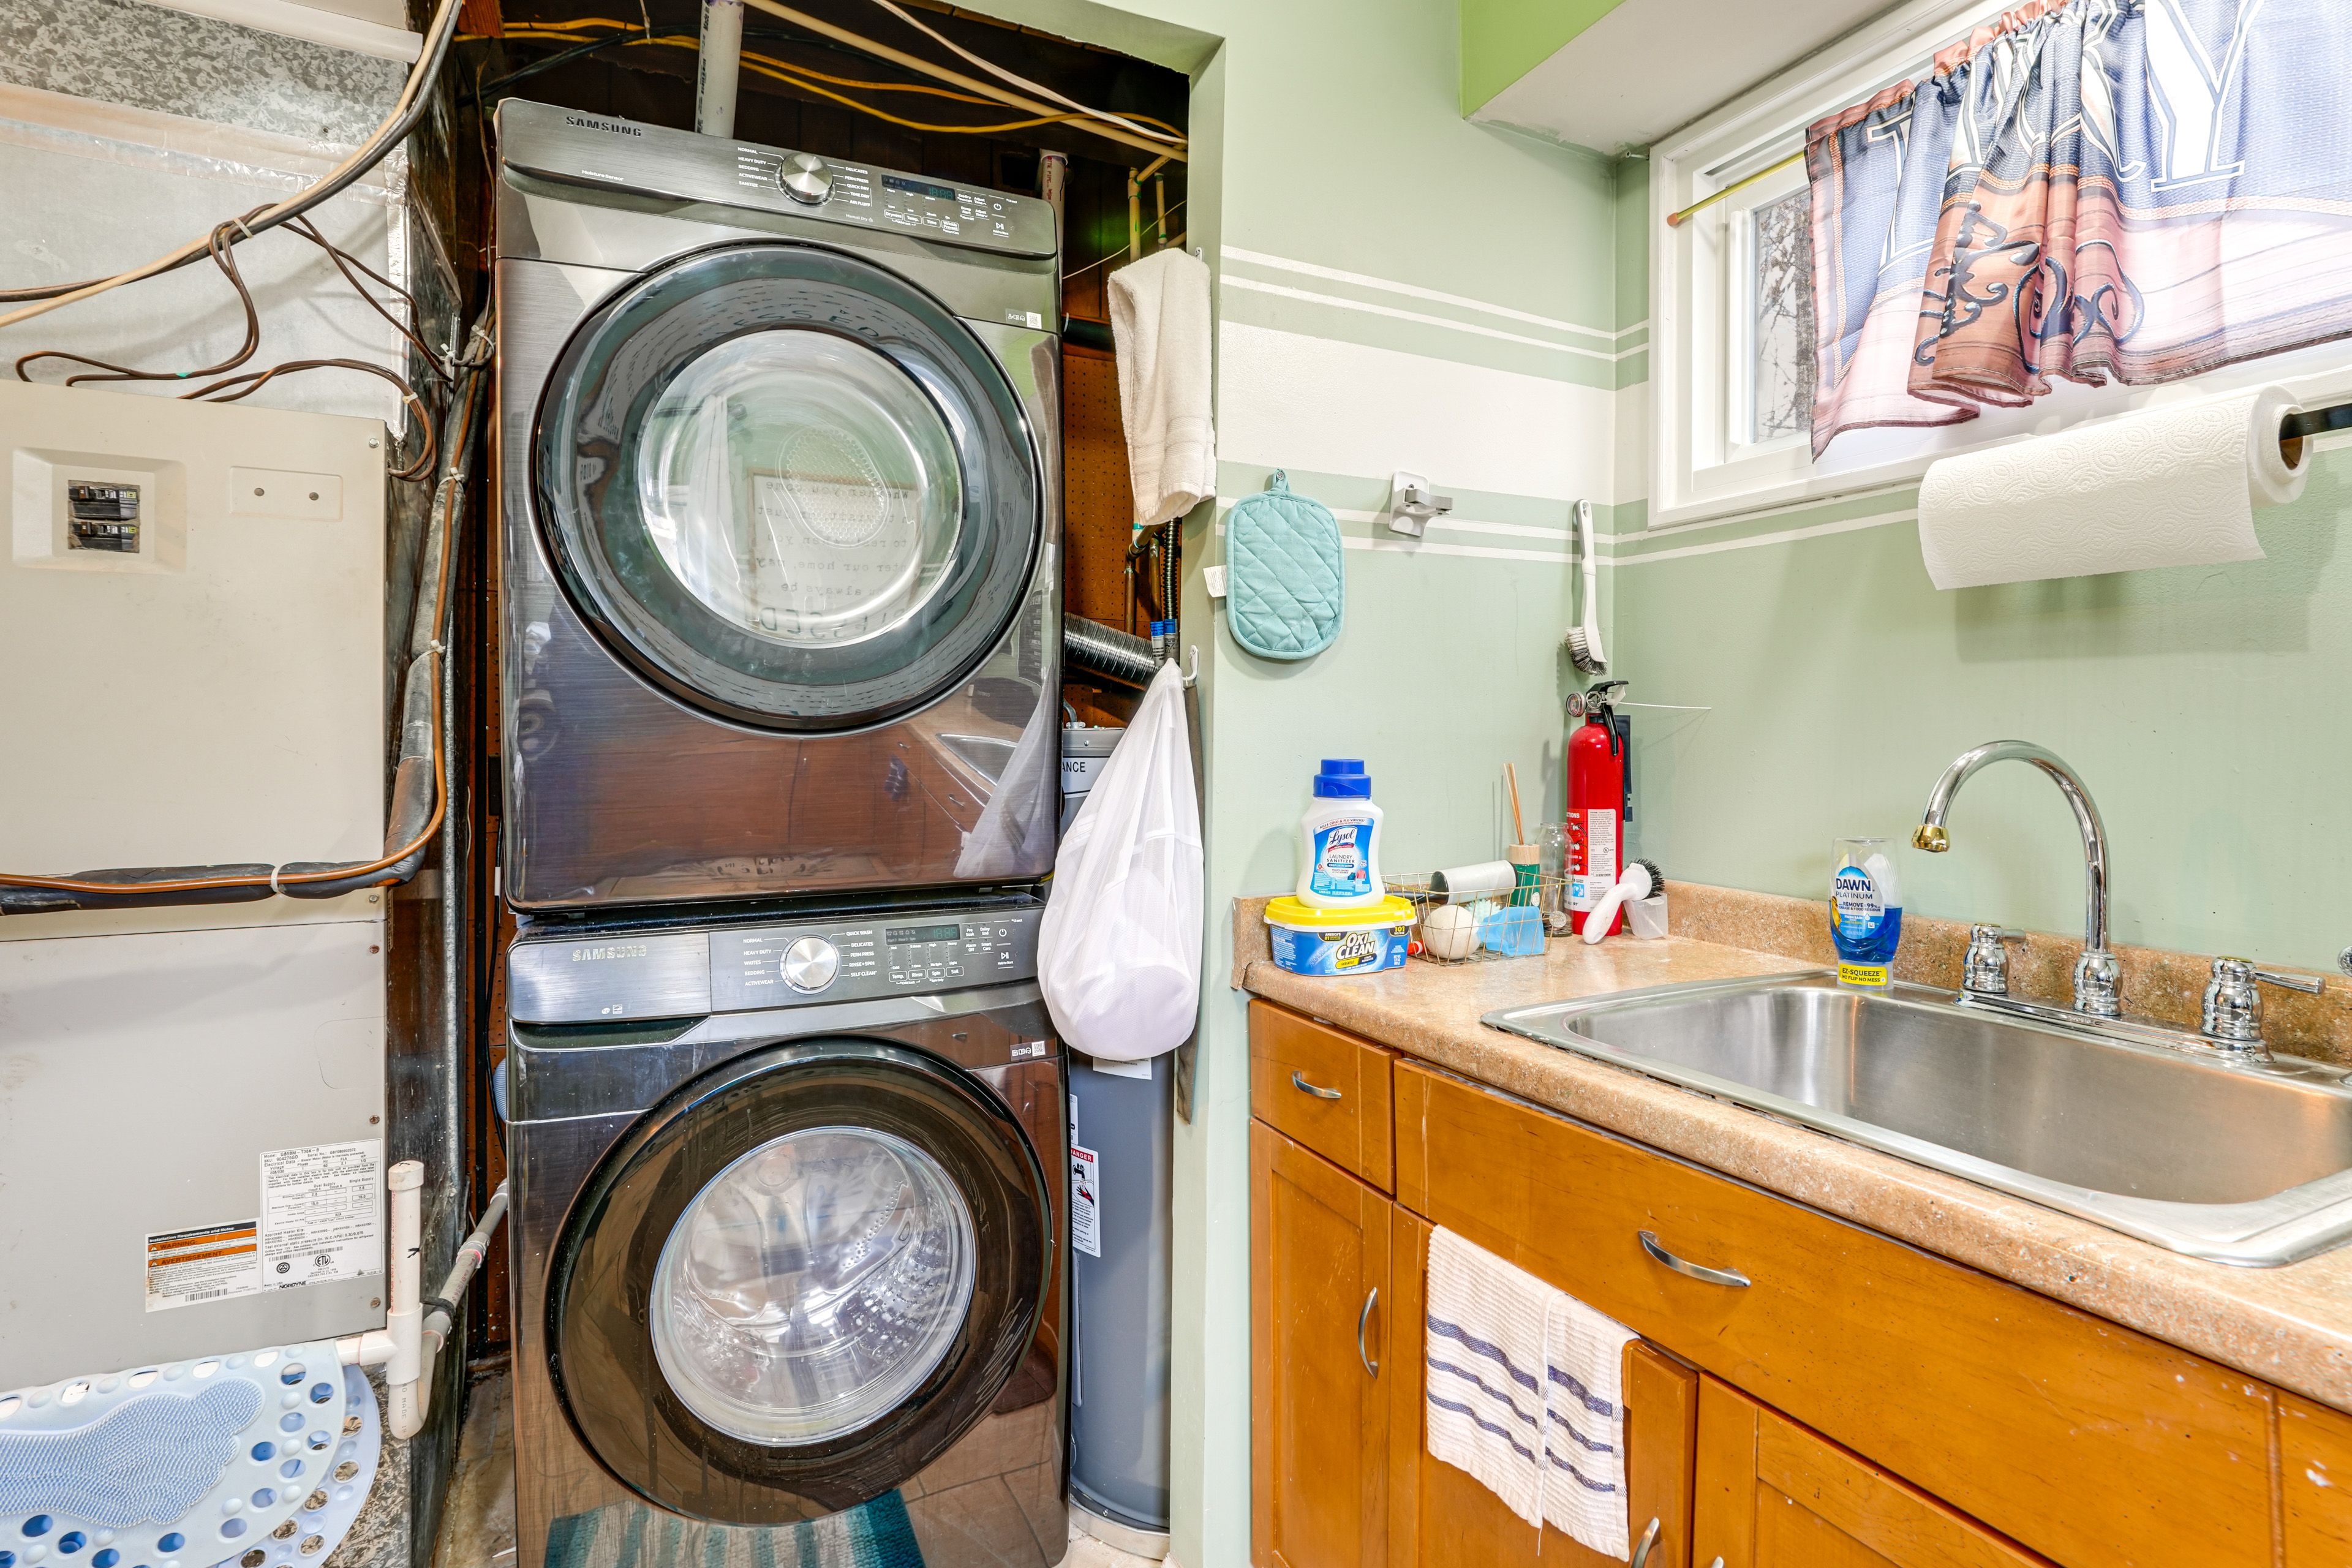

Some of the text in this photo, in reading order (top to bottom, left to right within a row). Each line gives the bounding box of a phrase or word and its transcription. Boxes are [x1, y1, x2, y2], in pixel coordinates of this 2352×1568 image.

[566, 116, 642, 137] SAMSUNG
[738, 172, 767, 181] ACTIVEWEAR
[1329, 828, 1355, 846] Lysol
[1836, 878, 1871, 891] DAWN
[1348, 933, 1369, 947] OXI
[573, 945, 647, 961] SAMSUNG
[1336, 941, 1376, 960] CLEAN
[1842, 968, 1880, 977] EZ-SQUEEZE
[160, 1240, 197, 1250] WARNING:
[161, 1251, 224, 1265] AVERTISSEMENT:
[279, 1281, 306, 1289] NORDYNE
